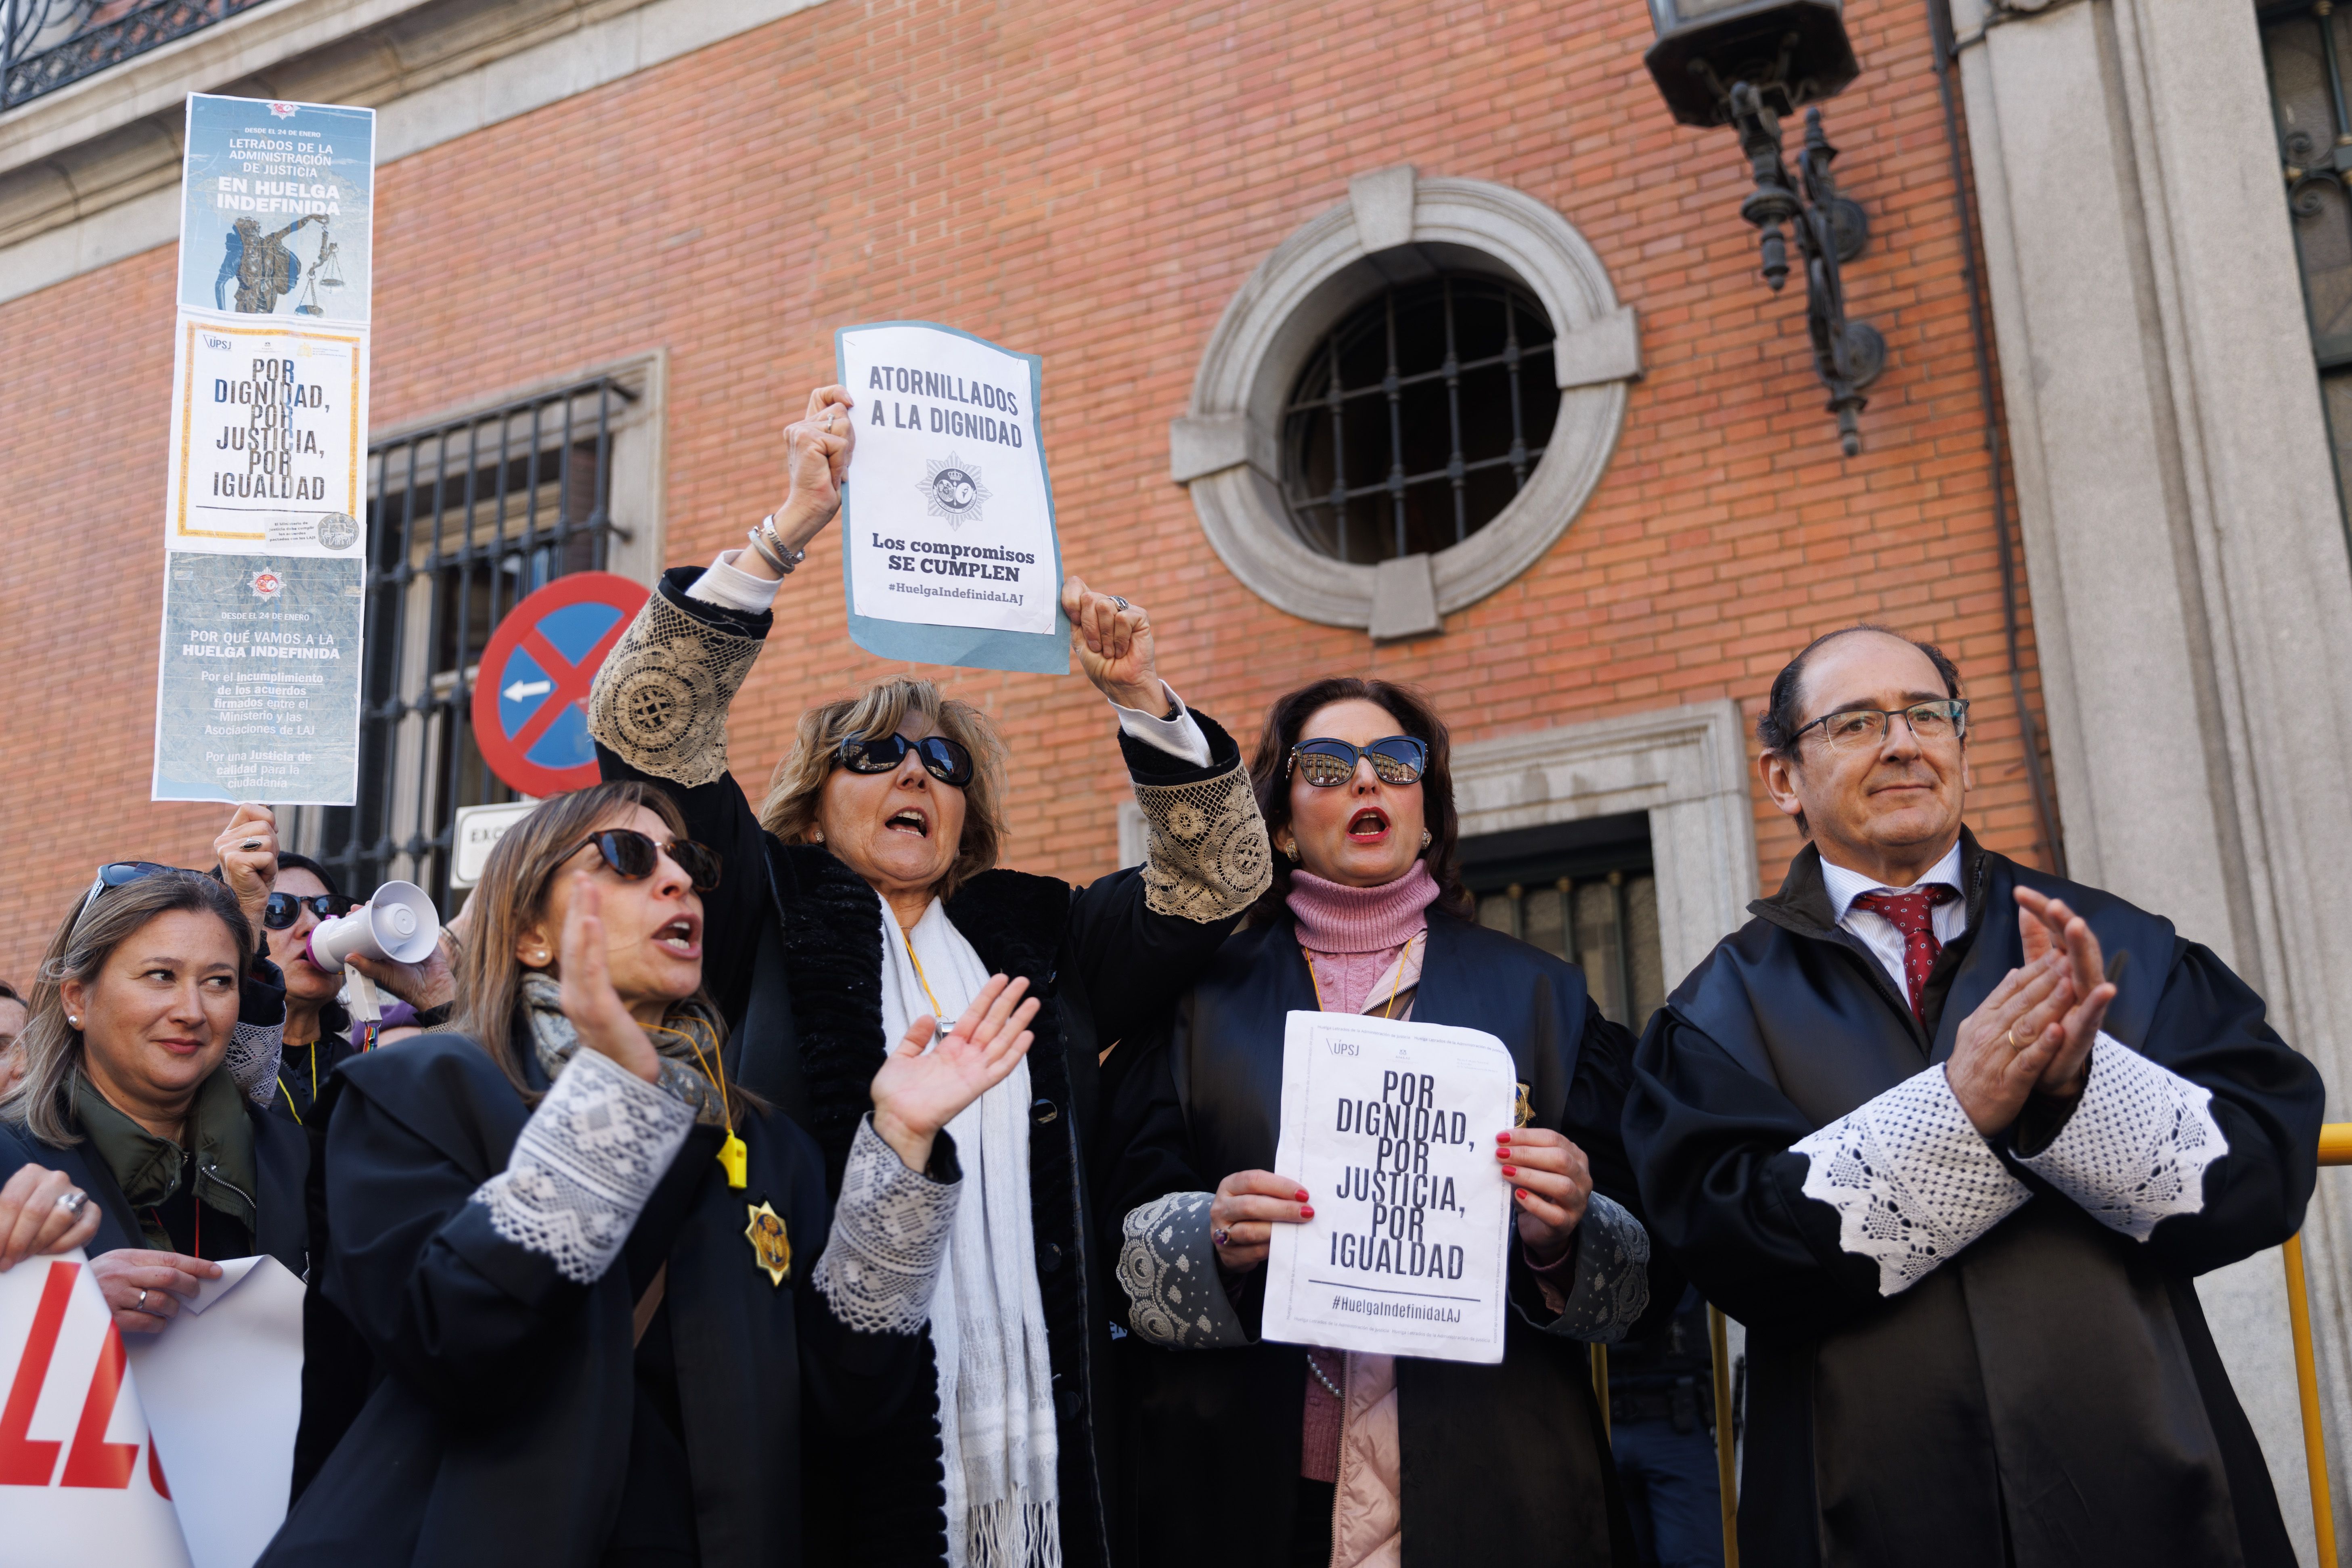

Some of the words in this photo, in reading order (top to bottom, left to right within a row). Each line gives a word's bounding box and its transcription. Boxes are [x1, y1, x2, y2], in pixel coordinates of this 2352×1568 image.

[229, 150, 331, 166] ADMINISTRACIÓN
[230, 138, 293, 151] LETRADOS
[298, 142, 314, 153] DE
[319, 144, 333, 154] LA
[243, 163, 260, 173] DE
[264, 164, 318, 178] JUSTICIA
[219, 176, 247, 193] EN
[255, 180, 340, 199] HUELGA
[217, 193, 340, 216] INDEFINIDA
[252, 358, 294, 383] POR
[215, 379, 330, 413] DIGNIDAD,
[870, 366, 1018, 416] ATORNILLADOS
[250, 404, 293, 429] POR
[871, 400, 885, 426] A
[895, 402, 922, 431] LA
[931, 407, 1022, 448] DIGNIDAD
[216, 427, 324, 458] JUSTICIA,
[249, 450, 291, 477] POR
[214, 472, 325, 500] IGUALDAD
[873, 533, 905, 551] Los
[910, 539, 1035, 565] compromisos
[889, 555, 915, 572] SE
[920, 559, 1020, 582] CUMPLEN
[889, 583, 1024, 606] #HuelgaIndefinidaLAJ
[191, 630, 218, 643] POR
[224, 630, 250, 644] QUÉ
[254, 632, 301, 644] VAMOS
[306, 634, 314, 645] A
[319, 634, 334, 645] LA
[183, 645, 246, 657] HUELGA
[251, 646, 340, 659] INDEFINIDA
[202, 671, 221, 682] Por
[223, 672, 234, 682] el
[237, 672, 323, 685] incumplimiento
[218, 685, 231, 695] de
[236, 685, 251, 695] los
[254, 685, 306, 695] acuerdos
[214, 698, 263, 708] firmados
[266, 700, 295, 709] entre
[298, 699, 308, 709] el
[205, 724, 276, 735] Asociaciones
[280, 725, 293, 735] de
[297, 725, 315, 735] LAJ
[220, 711, 273, 722] Ministerio
[276, 714, 283, 724] y
[286, 712, 302, 722] las
[206, 752, 224, 762] Por
[228, 753, 247, 761] una
[249, 750, 294, 762] Justicia
[297, 752, 312, 761] de
[217, 764, 257, 775] calidad
[261, 766, 285, 777] para
[290, 764, 299, 775] la
[228, 778, 287, 789] ciudadanía
[1382, 1070, 1434, 1109] POR
[1336, 1098, 1475, 1152] DIGNIDAD,
[1377, 1137, 1428, 1175] POR
[1336, 1165, 1466, 1218] JUSTICIA,
[1372, 1202, 1424, 1242] POR
[1330, 1231, 1464, 1280] IGUALDAD
[1332, 1294, 1460, 1323] #HuelgaIndefinidaLAJ
